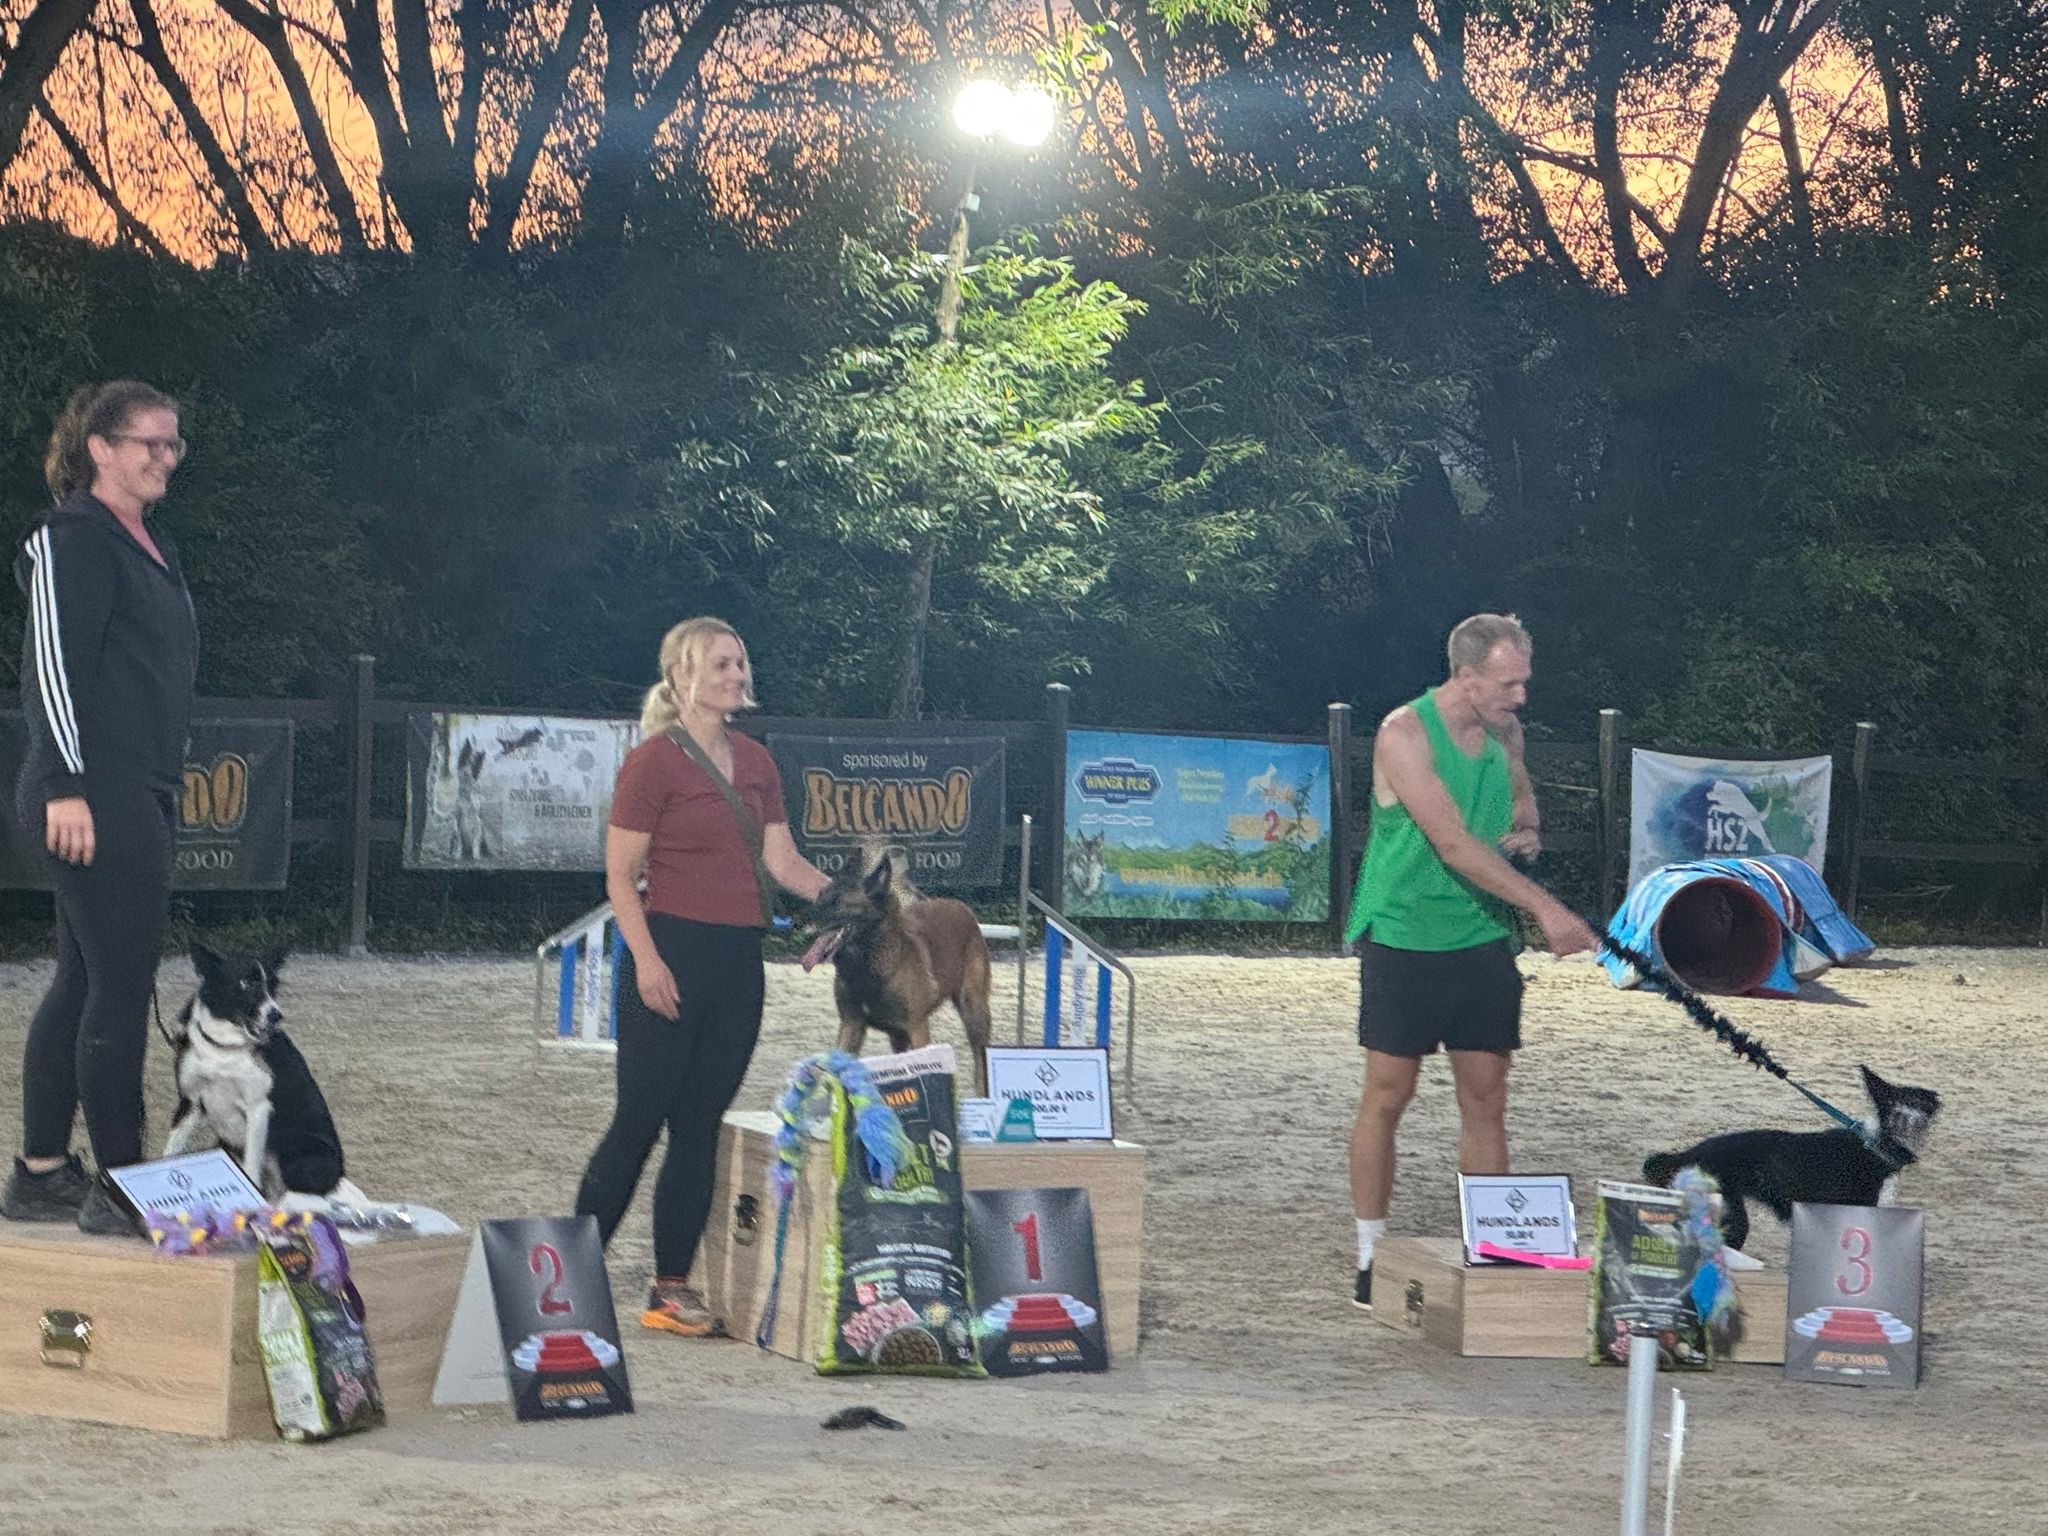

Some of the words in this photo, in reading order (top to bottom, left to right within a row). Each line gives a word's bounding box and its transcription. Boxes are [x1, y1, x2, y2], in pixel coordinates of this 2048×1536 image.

[842, 753, 909, 771] sponsored
[912, 752, 928, 772] by
[804, 770, 971, 834] BELCANDO
[1705, 816, 1749, 851] HSZ
[915, 851, 961, 869] FOOD
[1001, 1088, 1096, 1102] HUNDLANDS
[1476, 1215, 1560, 1227] HUNDLANDS
[1013, 1212, 1044, 1282] 1
[1835, 1226, 1874, 1297] 3
[528, 1242, 574, 1317] 2
